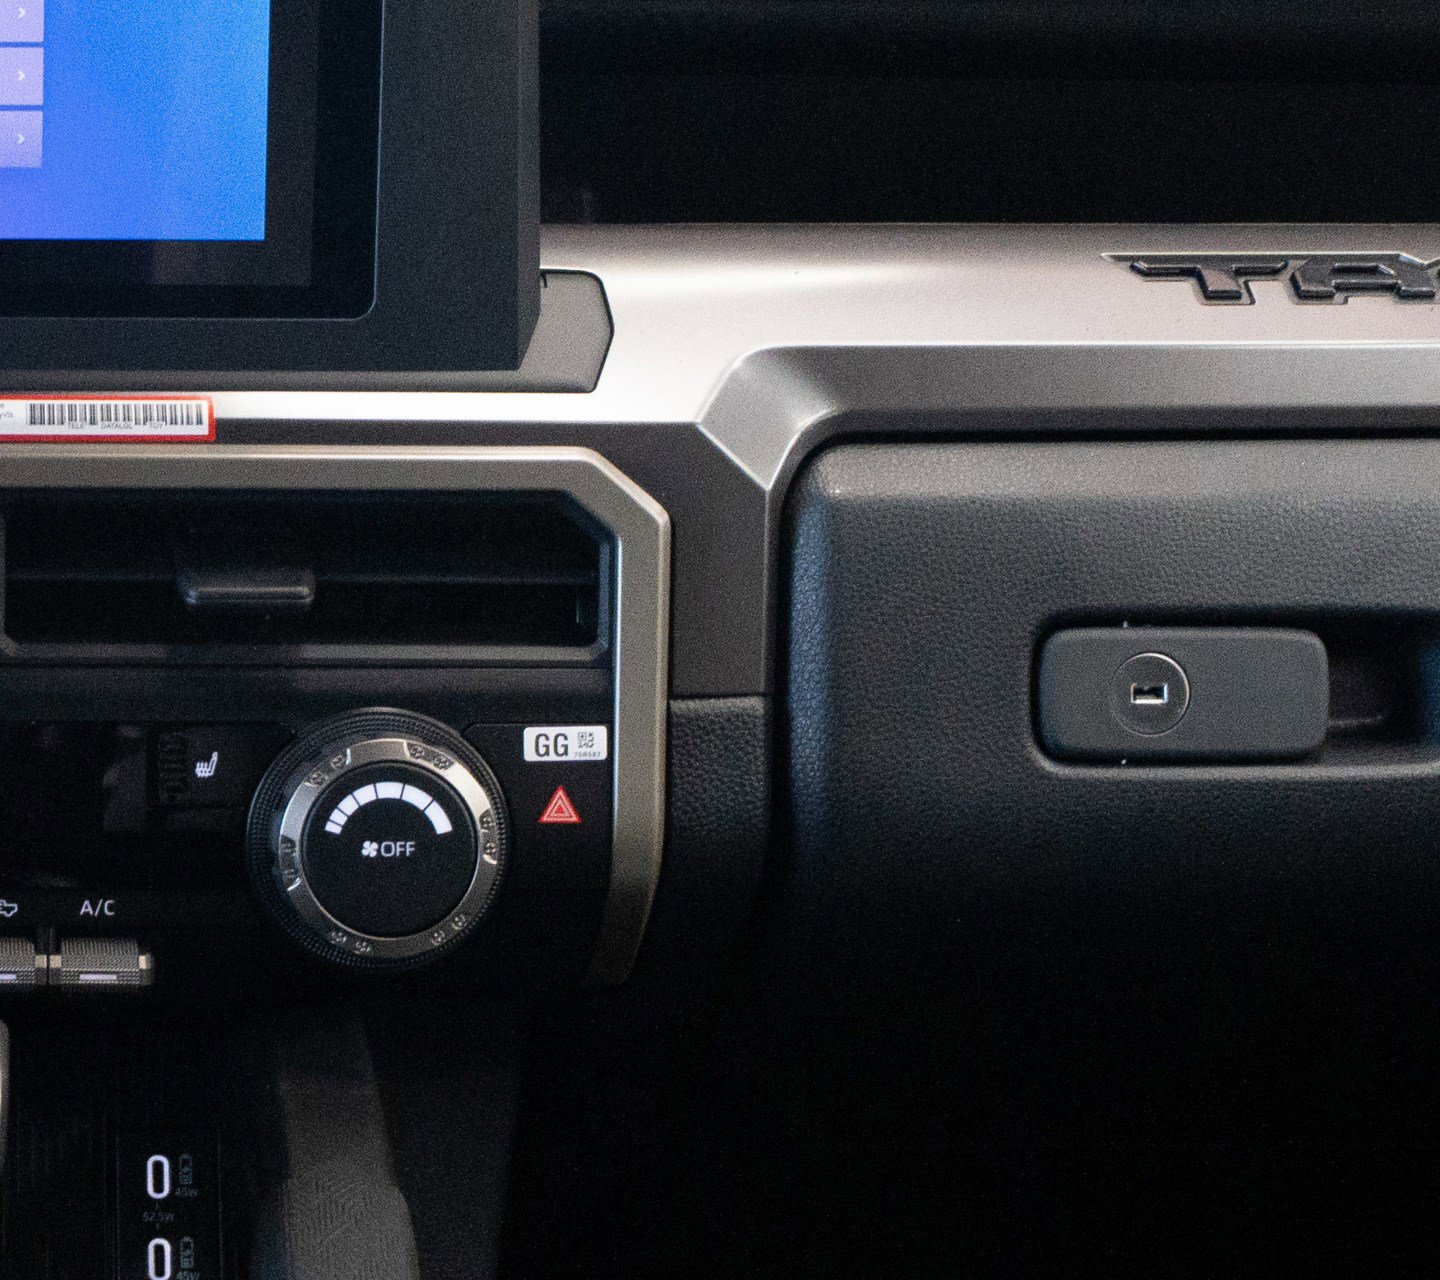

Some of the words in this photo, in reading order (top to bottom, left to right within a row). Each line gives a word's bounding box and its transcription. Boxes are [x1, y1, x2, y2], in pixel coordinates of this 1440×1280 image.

[534, 732, 569, 757] GG
[381, 840, 416, 859] OFF
[80, 899, 115, 916] A/C
